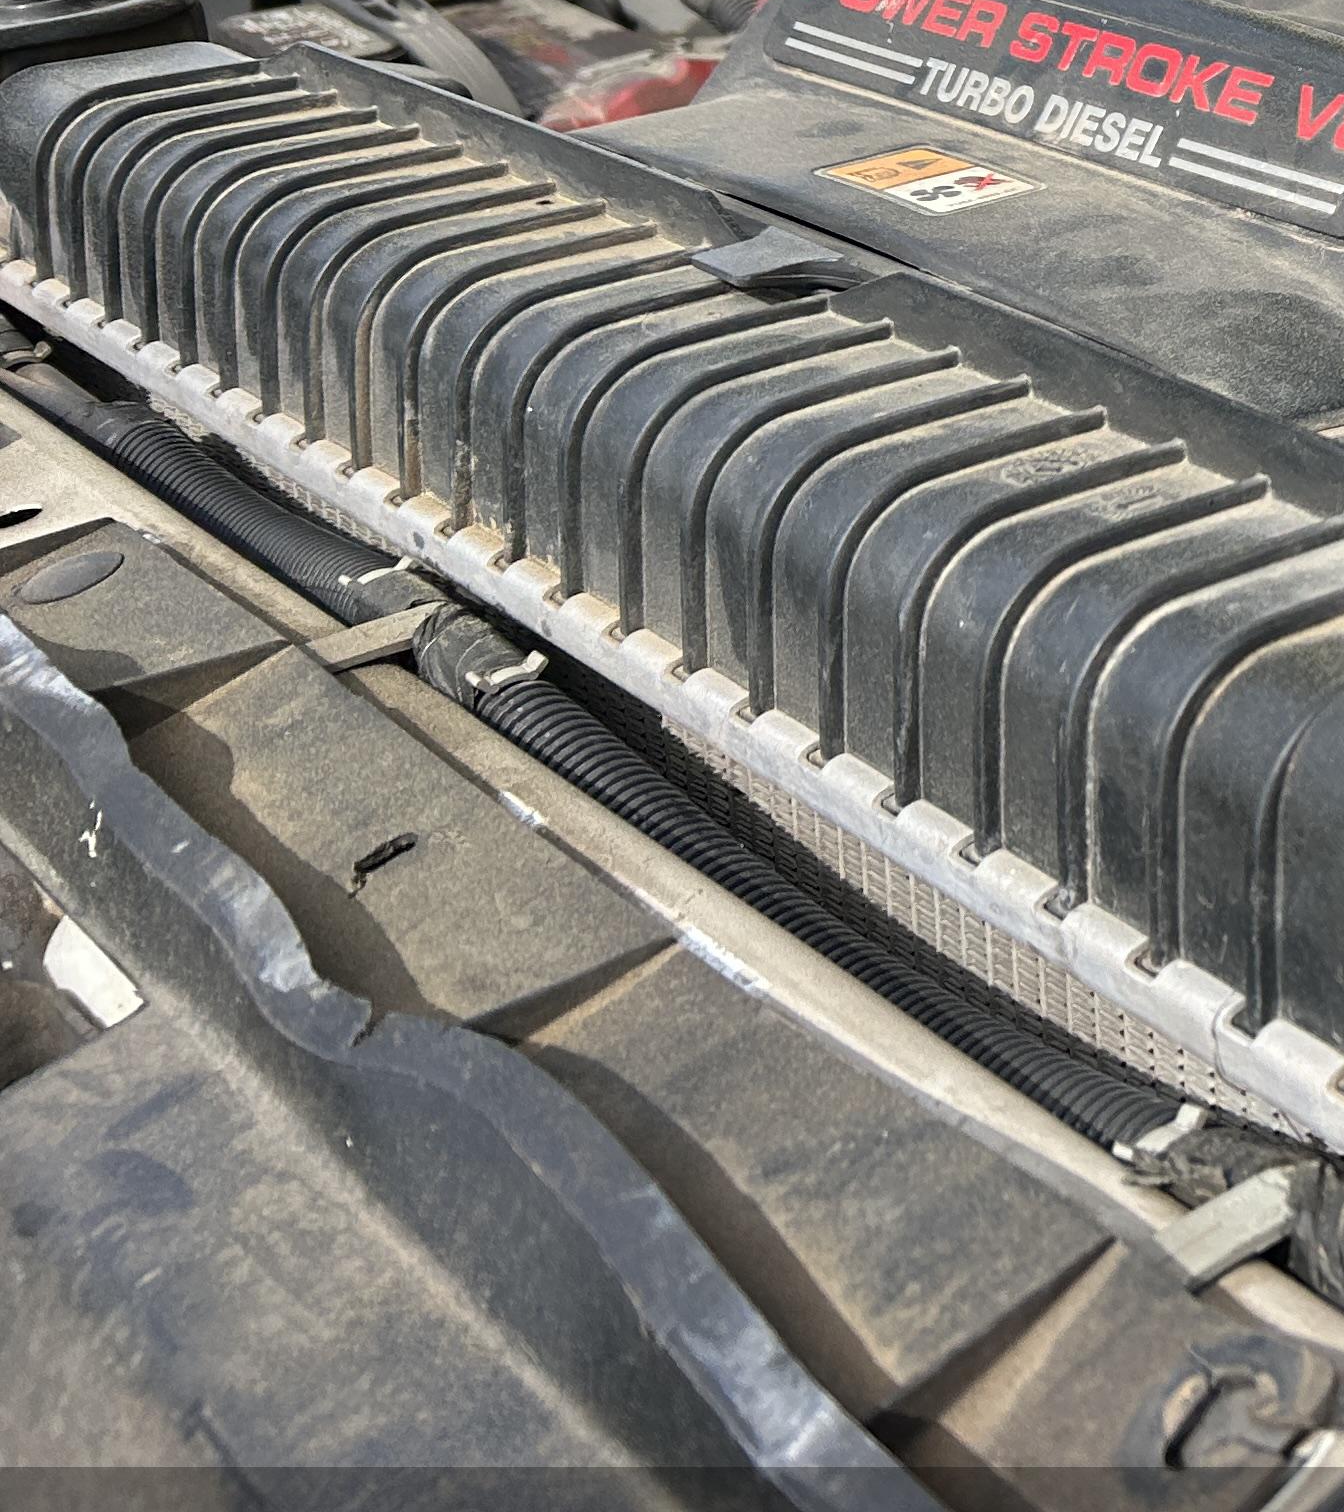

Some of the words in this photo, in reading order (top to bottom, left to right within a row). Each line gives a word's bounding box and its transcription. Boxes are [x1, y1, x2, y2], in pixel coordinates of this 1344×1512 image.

[917, 57, 1036, 125] TURBO
[1036, 94, 1165, 169] DIESEL
[1009, 12, 1276, 126] STROKE
